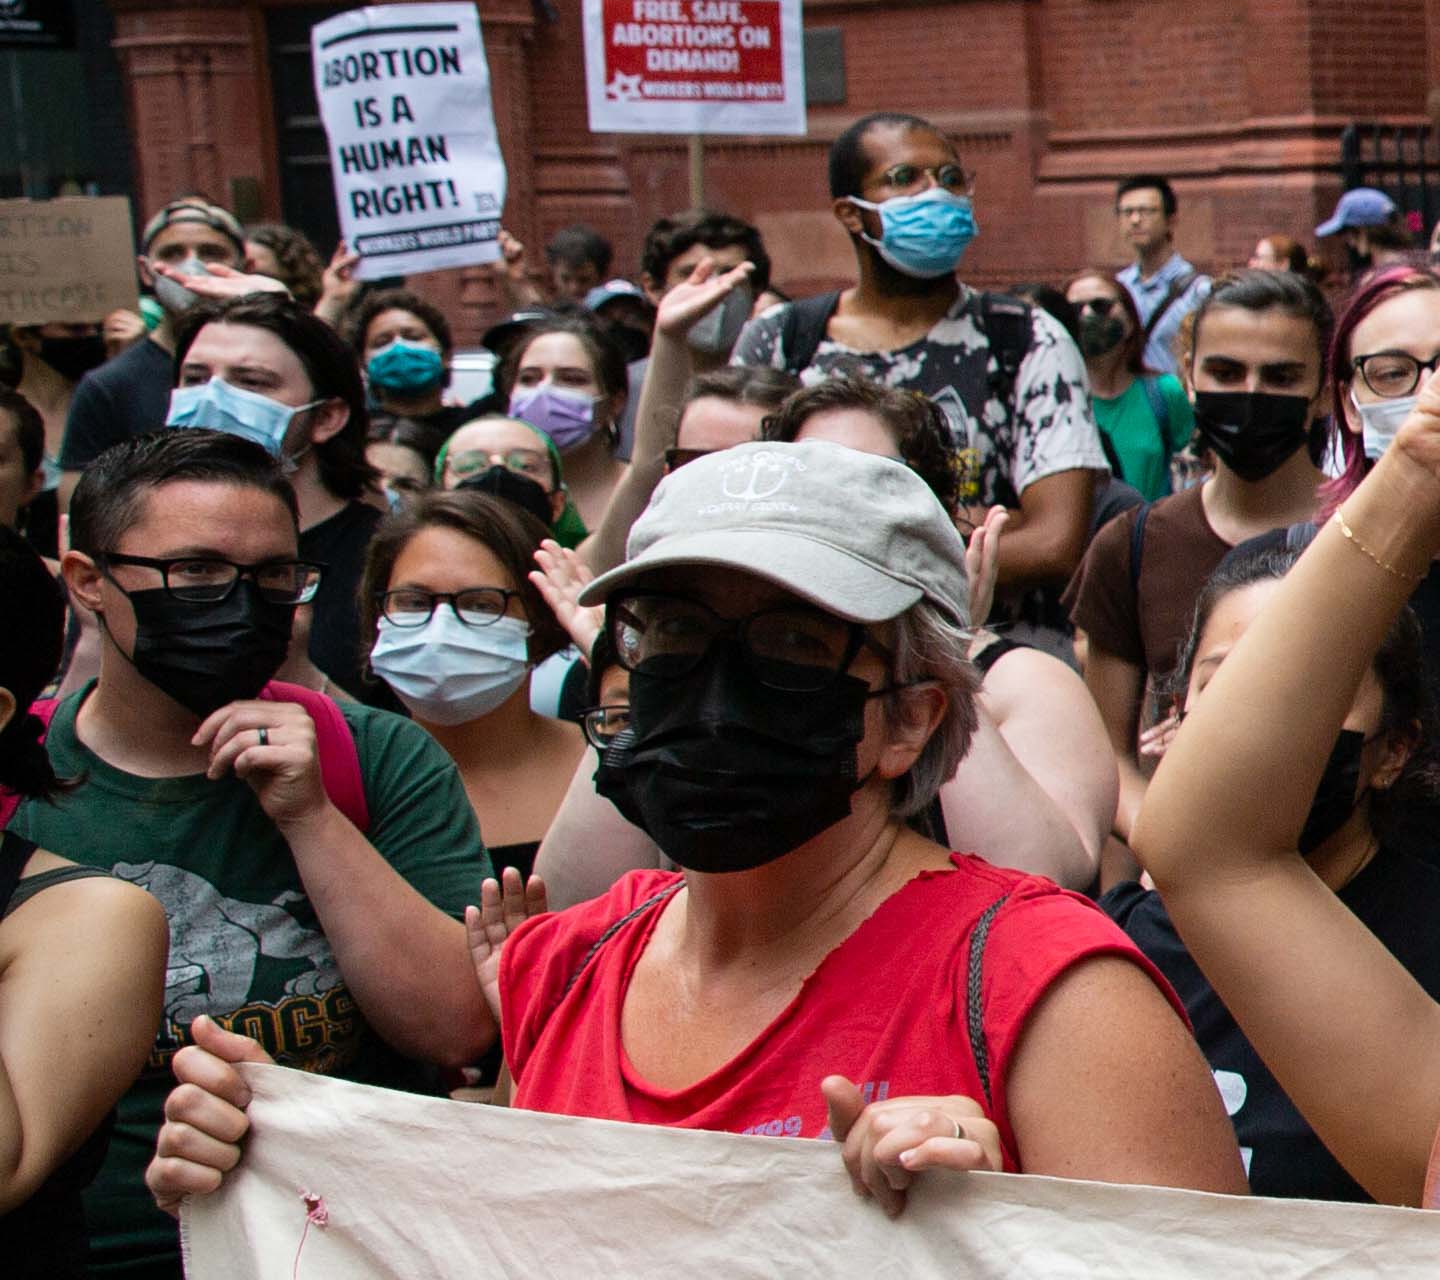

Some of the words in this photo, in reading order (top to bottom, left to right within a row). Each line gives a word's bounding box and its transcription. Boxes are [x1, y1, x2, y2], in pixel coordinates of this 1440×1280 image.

[612, 23, 736, 48] ABORTIONS
[739, 26, 771, 49] ON
[323, 45, 463, 89] ABORTION
[646, 48, 741, 74] DEMAND!
[354, 95, 382, 129] IS
[391, 94, 415, 124] A
[338, 134, 450, 175] HUMAN
[351, 178, 461, 220] RIGHT!
